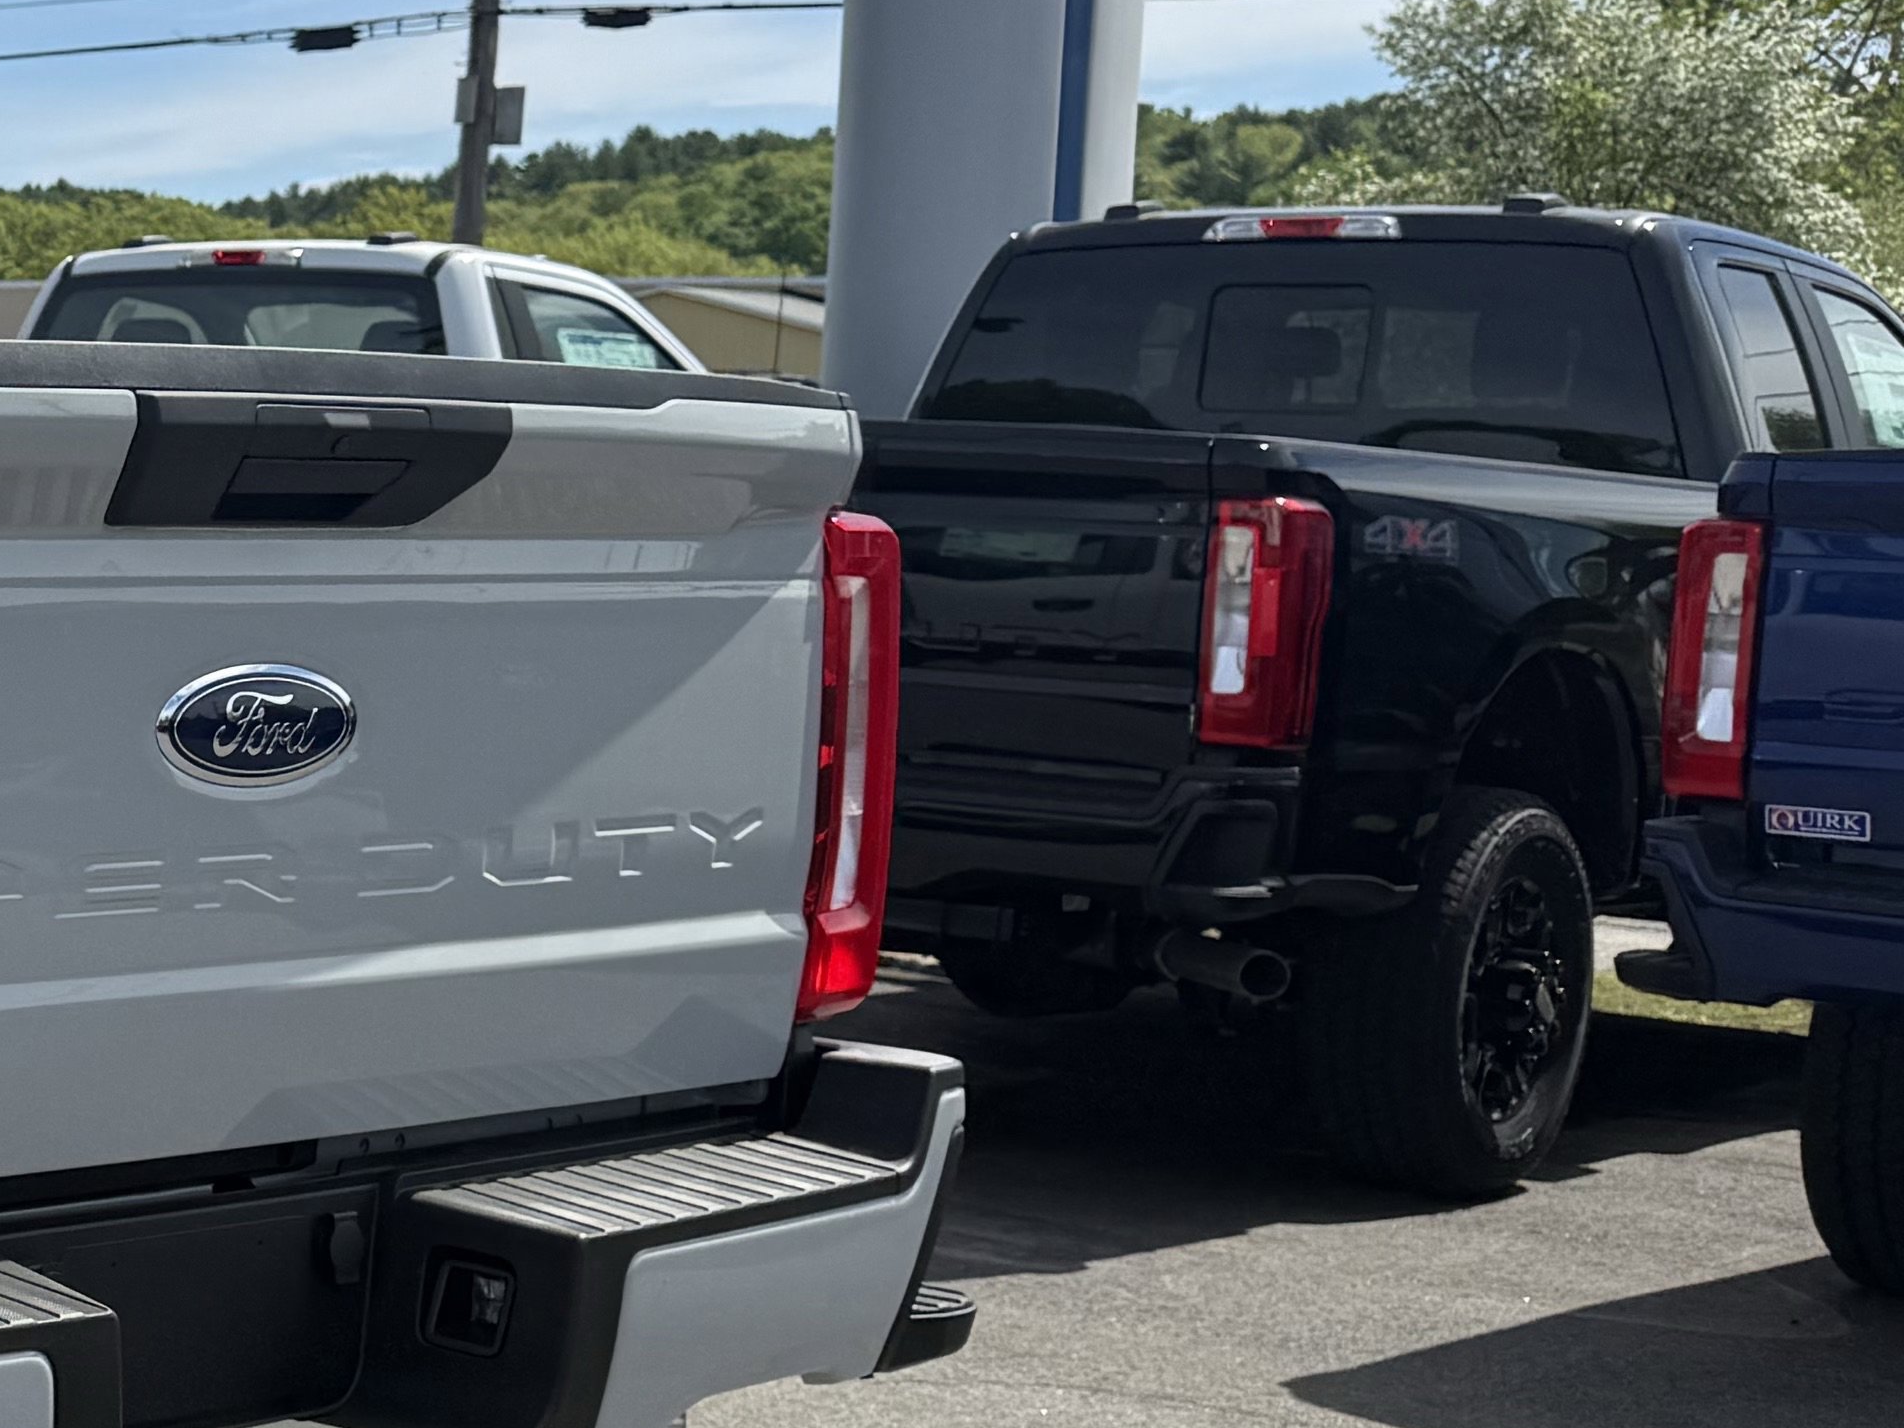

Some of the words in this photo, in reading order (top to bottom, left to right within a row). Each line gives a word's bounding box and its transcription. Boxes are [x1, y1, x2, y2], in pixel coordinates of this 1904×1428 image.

[212, 690, 319, 758] Ford
[355, 805, 766, 898] DUTY
[1770, 808, 1862, 832] QUIRK
